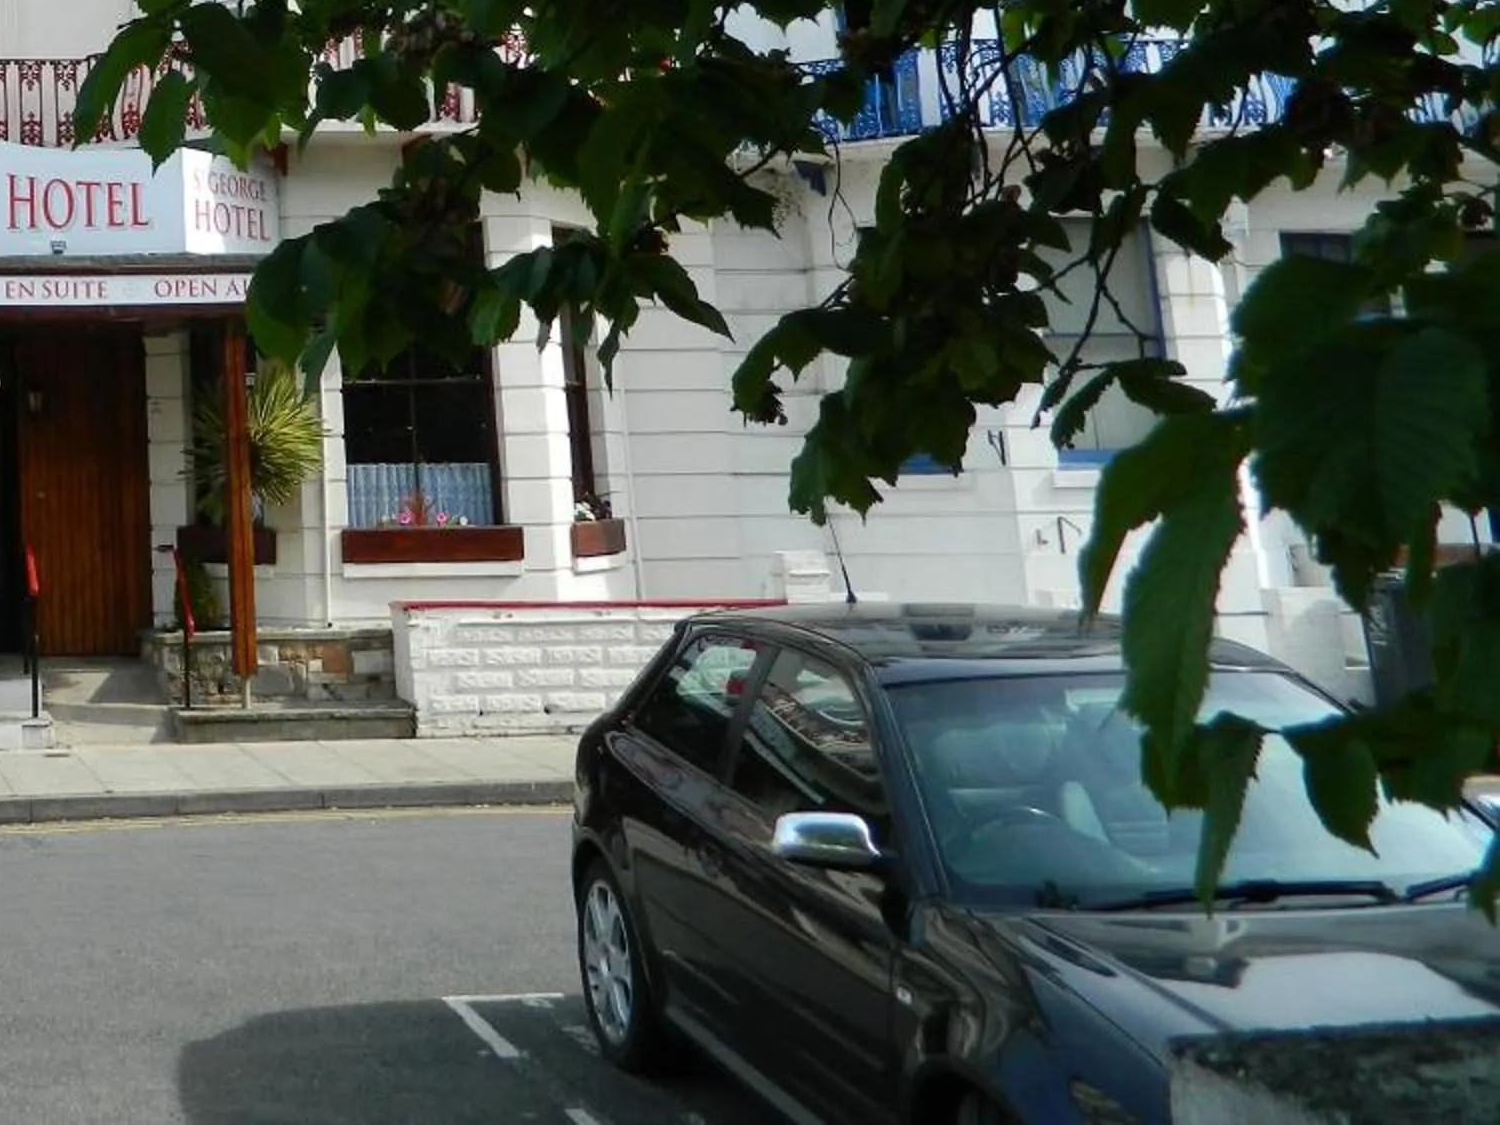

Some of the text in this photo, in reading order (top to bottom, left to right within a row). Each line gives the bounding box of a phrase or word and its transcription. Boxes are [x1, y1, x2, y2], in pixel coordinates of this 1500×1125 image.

[6, 173, 150, 230] HOTEL
[207, 170, 268, 203] GEORGE
[194, 198, 271, 243] HOTEL
[154, 278, 218, 297] OPEN
